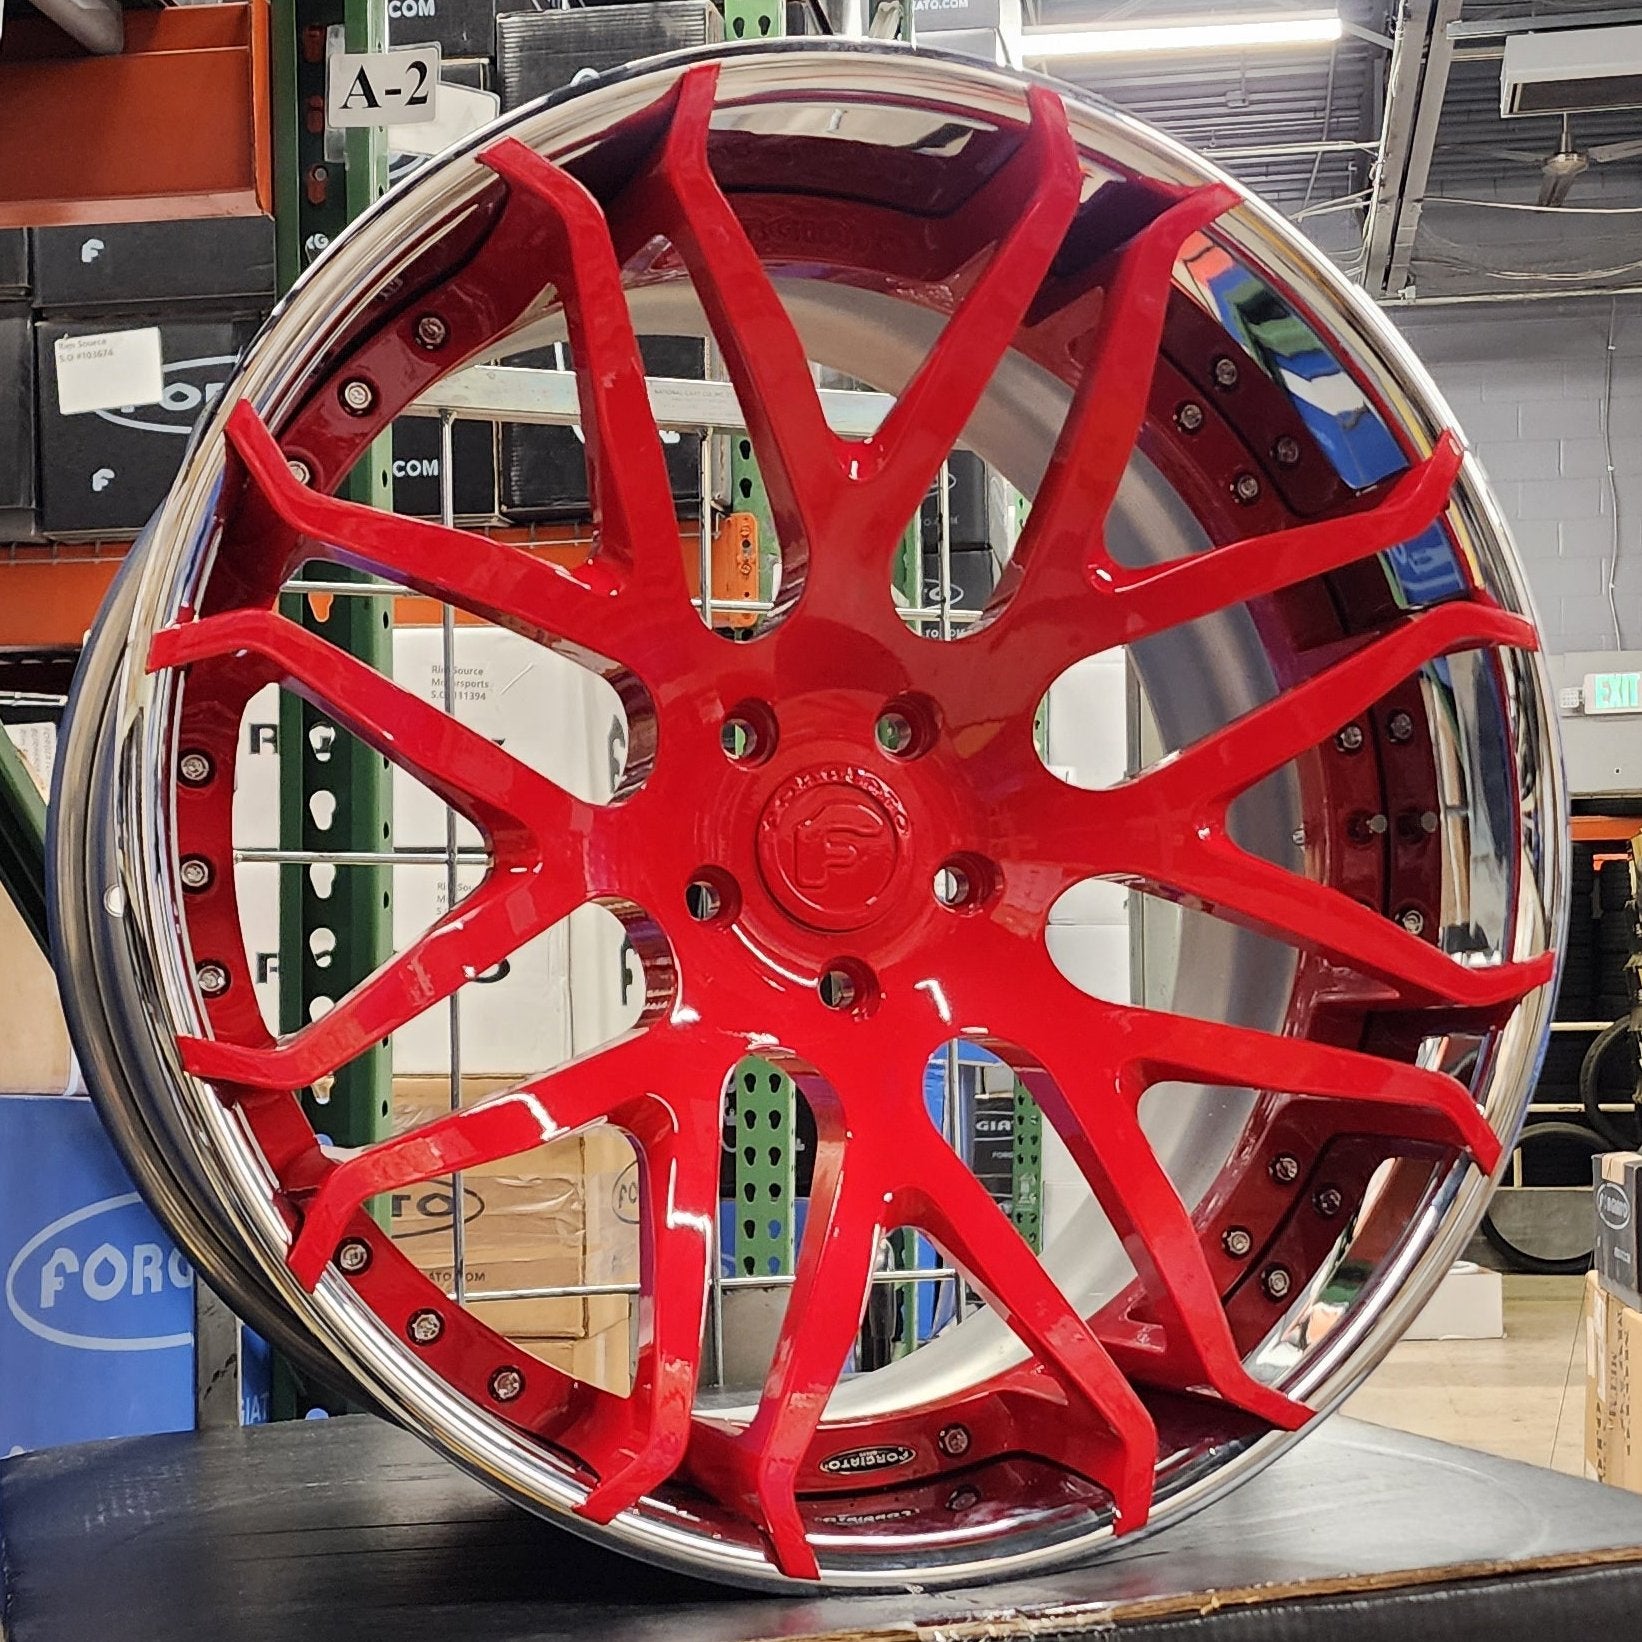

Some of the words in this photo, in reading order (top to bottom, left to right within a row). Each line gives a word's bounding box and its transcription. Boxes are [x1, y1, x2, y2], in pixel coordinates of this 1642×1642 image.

[388, 0, 436, 18] COM
[339, 61, 429, 109] A-2
[82, 238, 105, 263] F
[392, 459, 439, 477] COM
[92, 468, 115, 492] F
[431, 678, 489, 689] Mrsports
[976, 1119, 1014, 1132] GIA
[827, 1446, 910, 1470] FORGIATO
